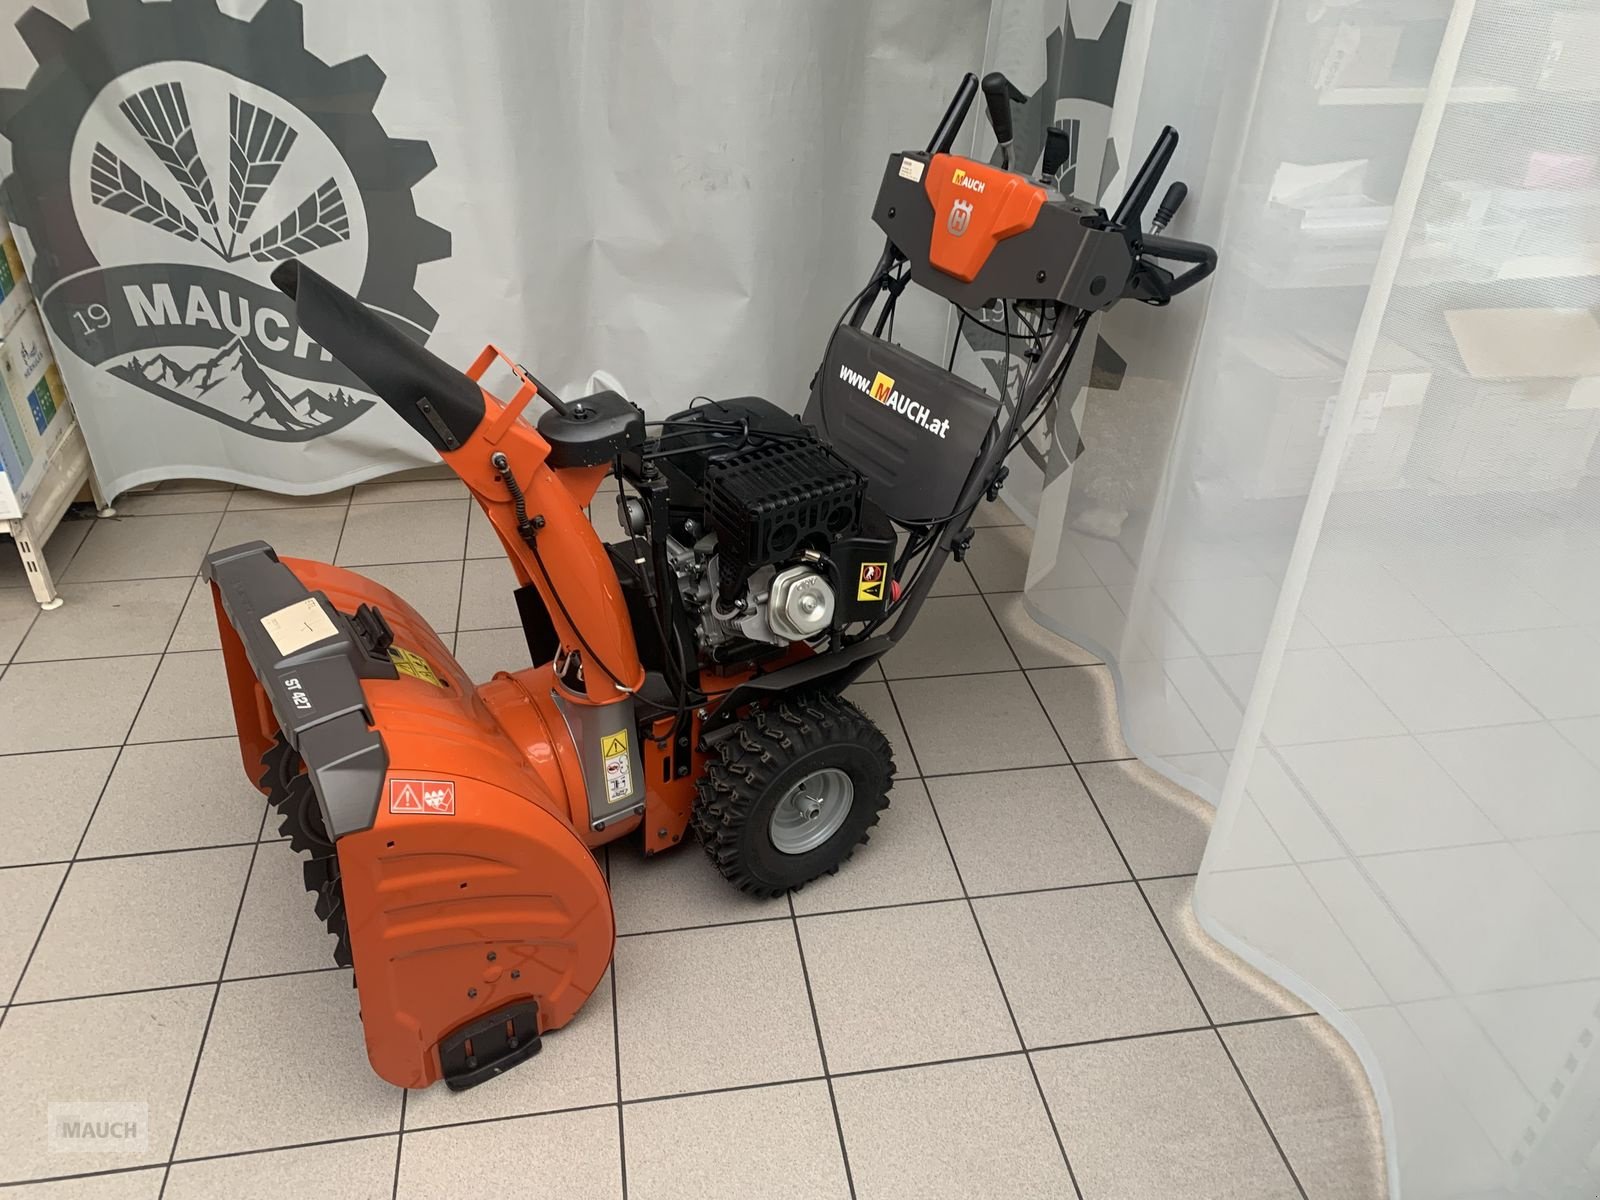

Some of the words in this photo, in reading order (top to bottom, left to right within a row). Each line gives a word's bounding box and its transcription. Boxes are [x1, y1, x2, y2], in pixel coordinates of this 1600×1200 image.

[953, 171, 985, 193] MAUCH
[73, 303, 111, 336] 19
[840, 364, 949, 438] www.MAUCH.at
[285, 678, 302, 690] ST
[292, 692, 312, 709] 427
